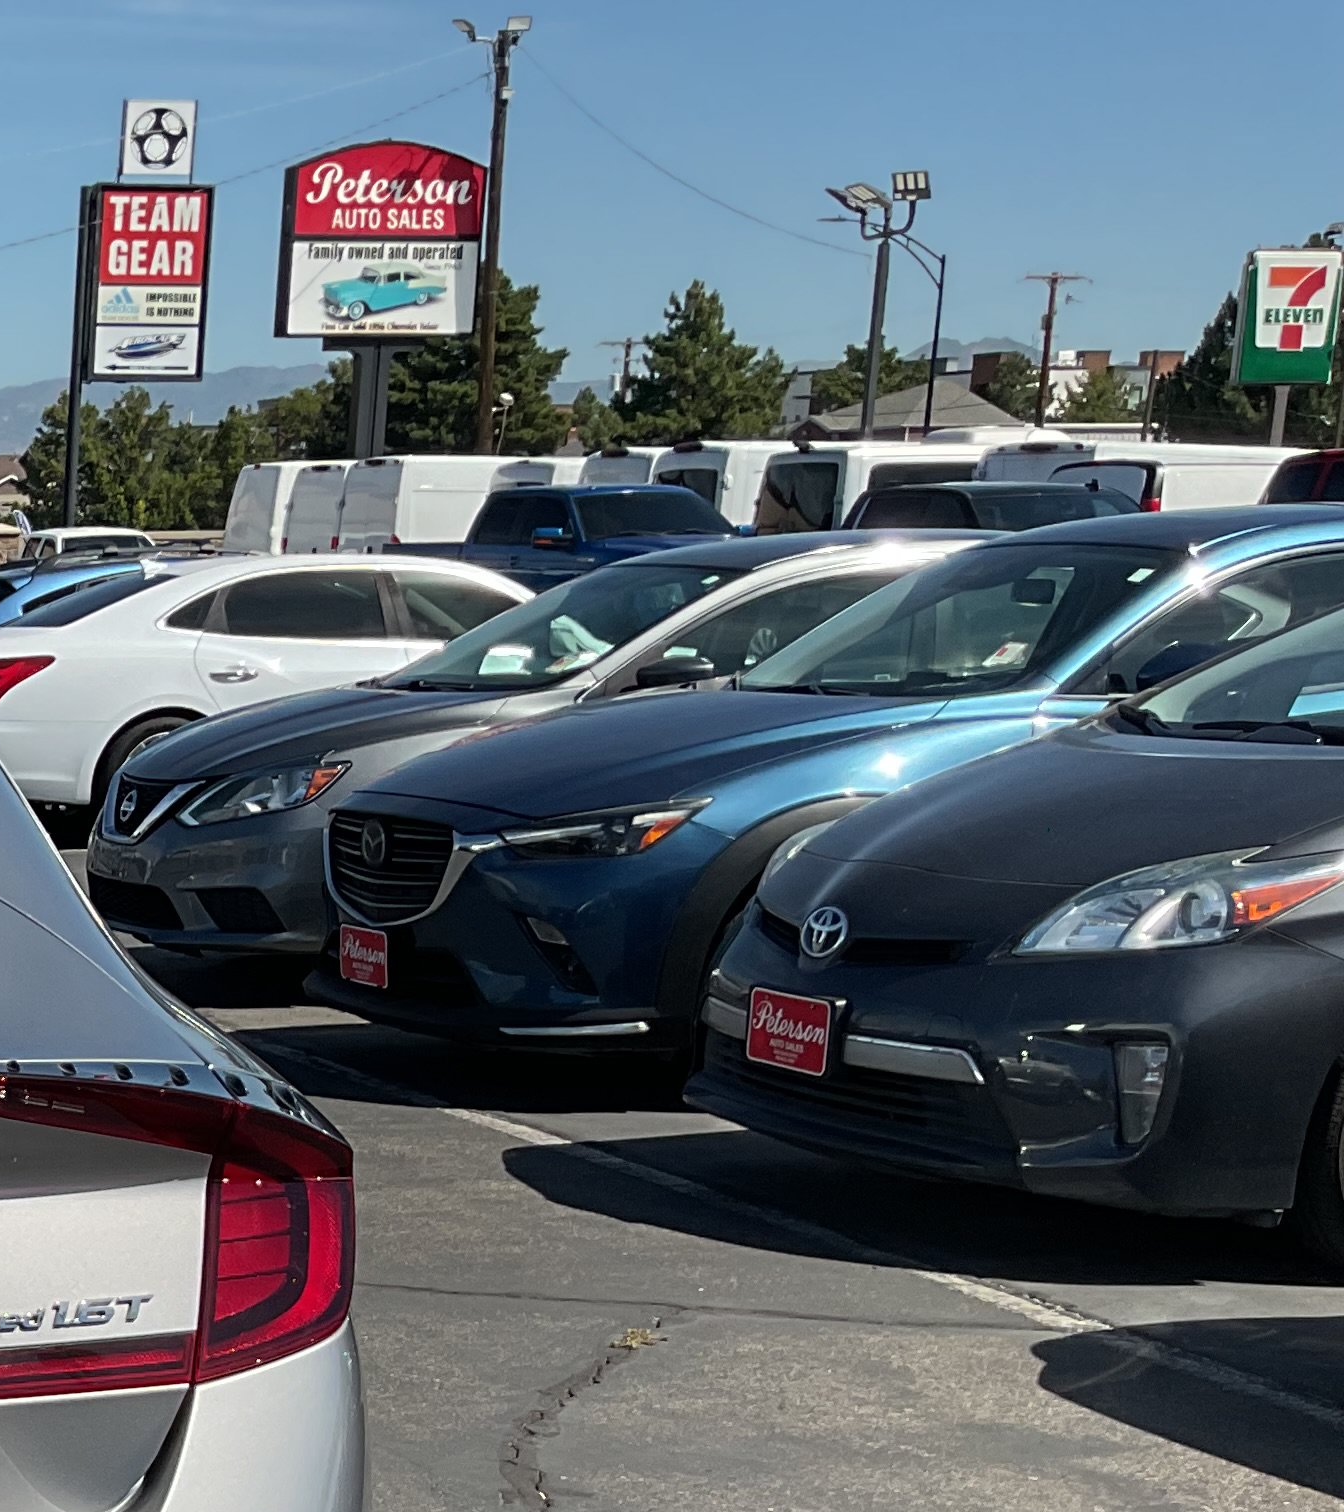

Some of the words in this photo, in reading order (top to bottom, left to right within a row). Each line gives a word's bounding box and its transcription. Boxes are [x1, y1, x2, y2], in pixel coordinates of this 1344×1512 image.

[306, 162, 473, 205] Peterson
[109, 195, 202, 233] TEAM
[331, 208, 381, 230] AUTO
[387, 207, 445, 230] SALES
[107, 239, 195, 276] GEAR
[308, 243, 345, 262] Family
[348, 243, 385, 260] owned
[388, 243, 409, 260] and
[412, 243, 464, 262] operated
[145, 292, 197, 304] IMPOSSIBLE
[145, 306, 155, 317] IS
[156, 306, 195, 318] NOTHING
[752, 1000, 825, 1045] Peterson
